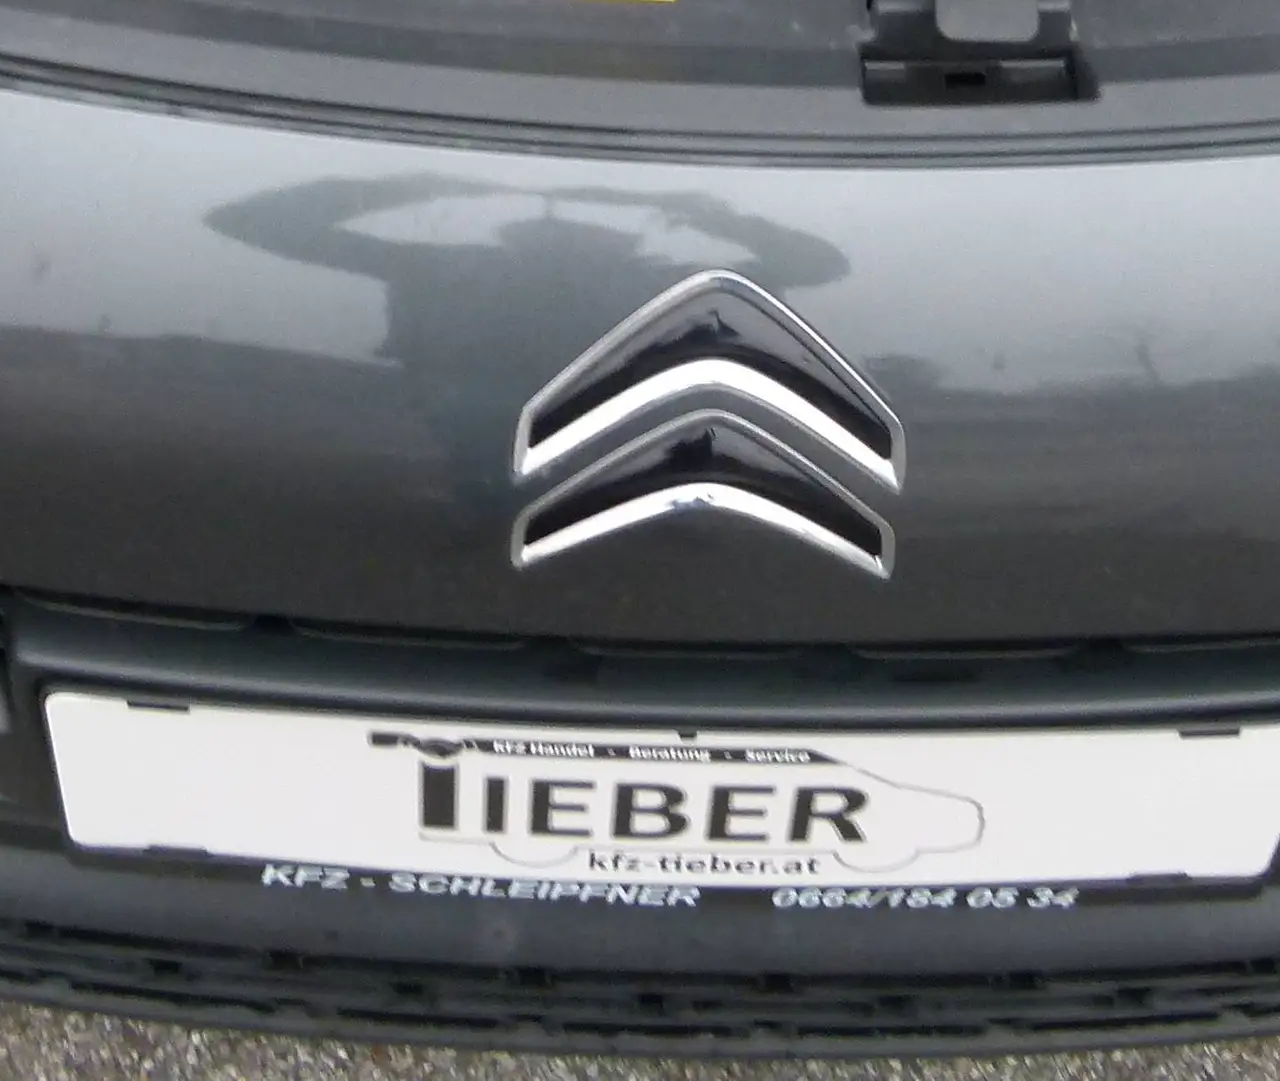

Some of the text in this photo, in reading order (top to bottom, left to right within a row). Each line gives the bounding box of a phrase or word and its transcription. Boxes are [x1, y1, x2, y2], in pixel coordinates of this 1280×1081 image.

[628, 745, 712, 763] Beratung
[745, 748, 812, 763] Service
[588, 852, 820, 875] kfz-tieber.at
[261, 864, 349, 890] KFZ
